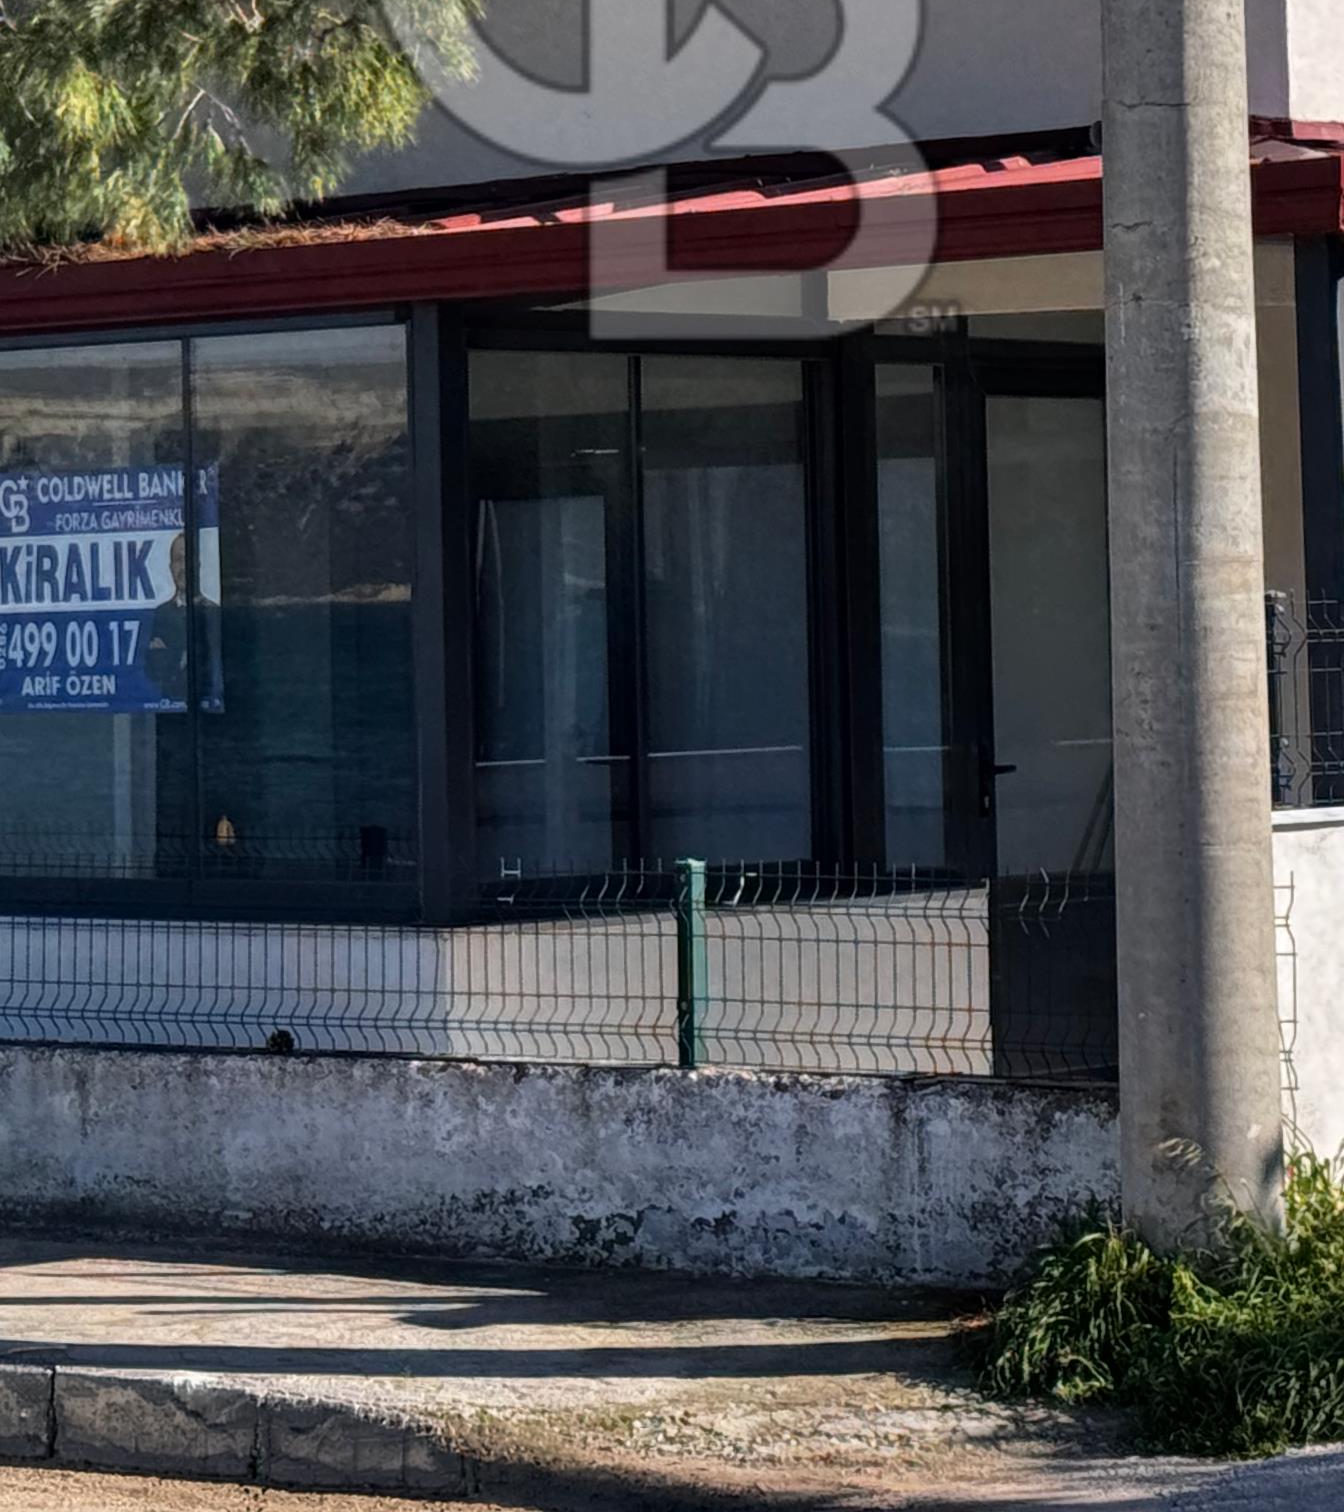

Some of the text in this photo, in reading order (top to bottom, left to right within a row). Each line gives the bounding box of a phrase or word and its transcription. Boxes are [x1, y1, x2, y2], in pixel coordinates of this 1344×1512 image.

[37, 474, 133, 504] COLDWELL
[56, 512, 97, 532] FORZA
[8, 620, 140, 668] 499 00 17
[22, 670, 116, 696] ARİF ÖZEN
